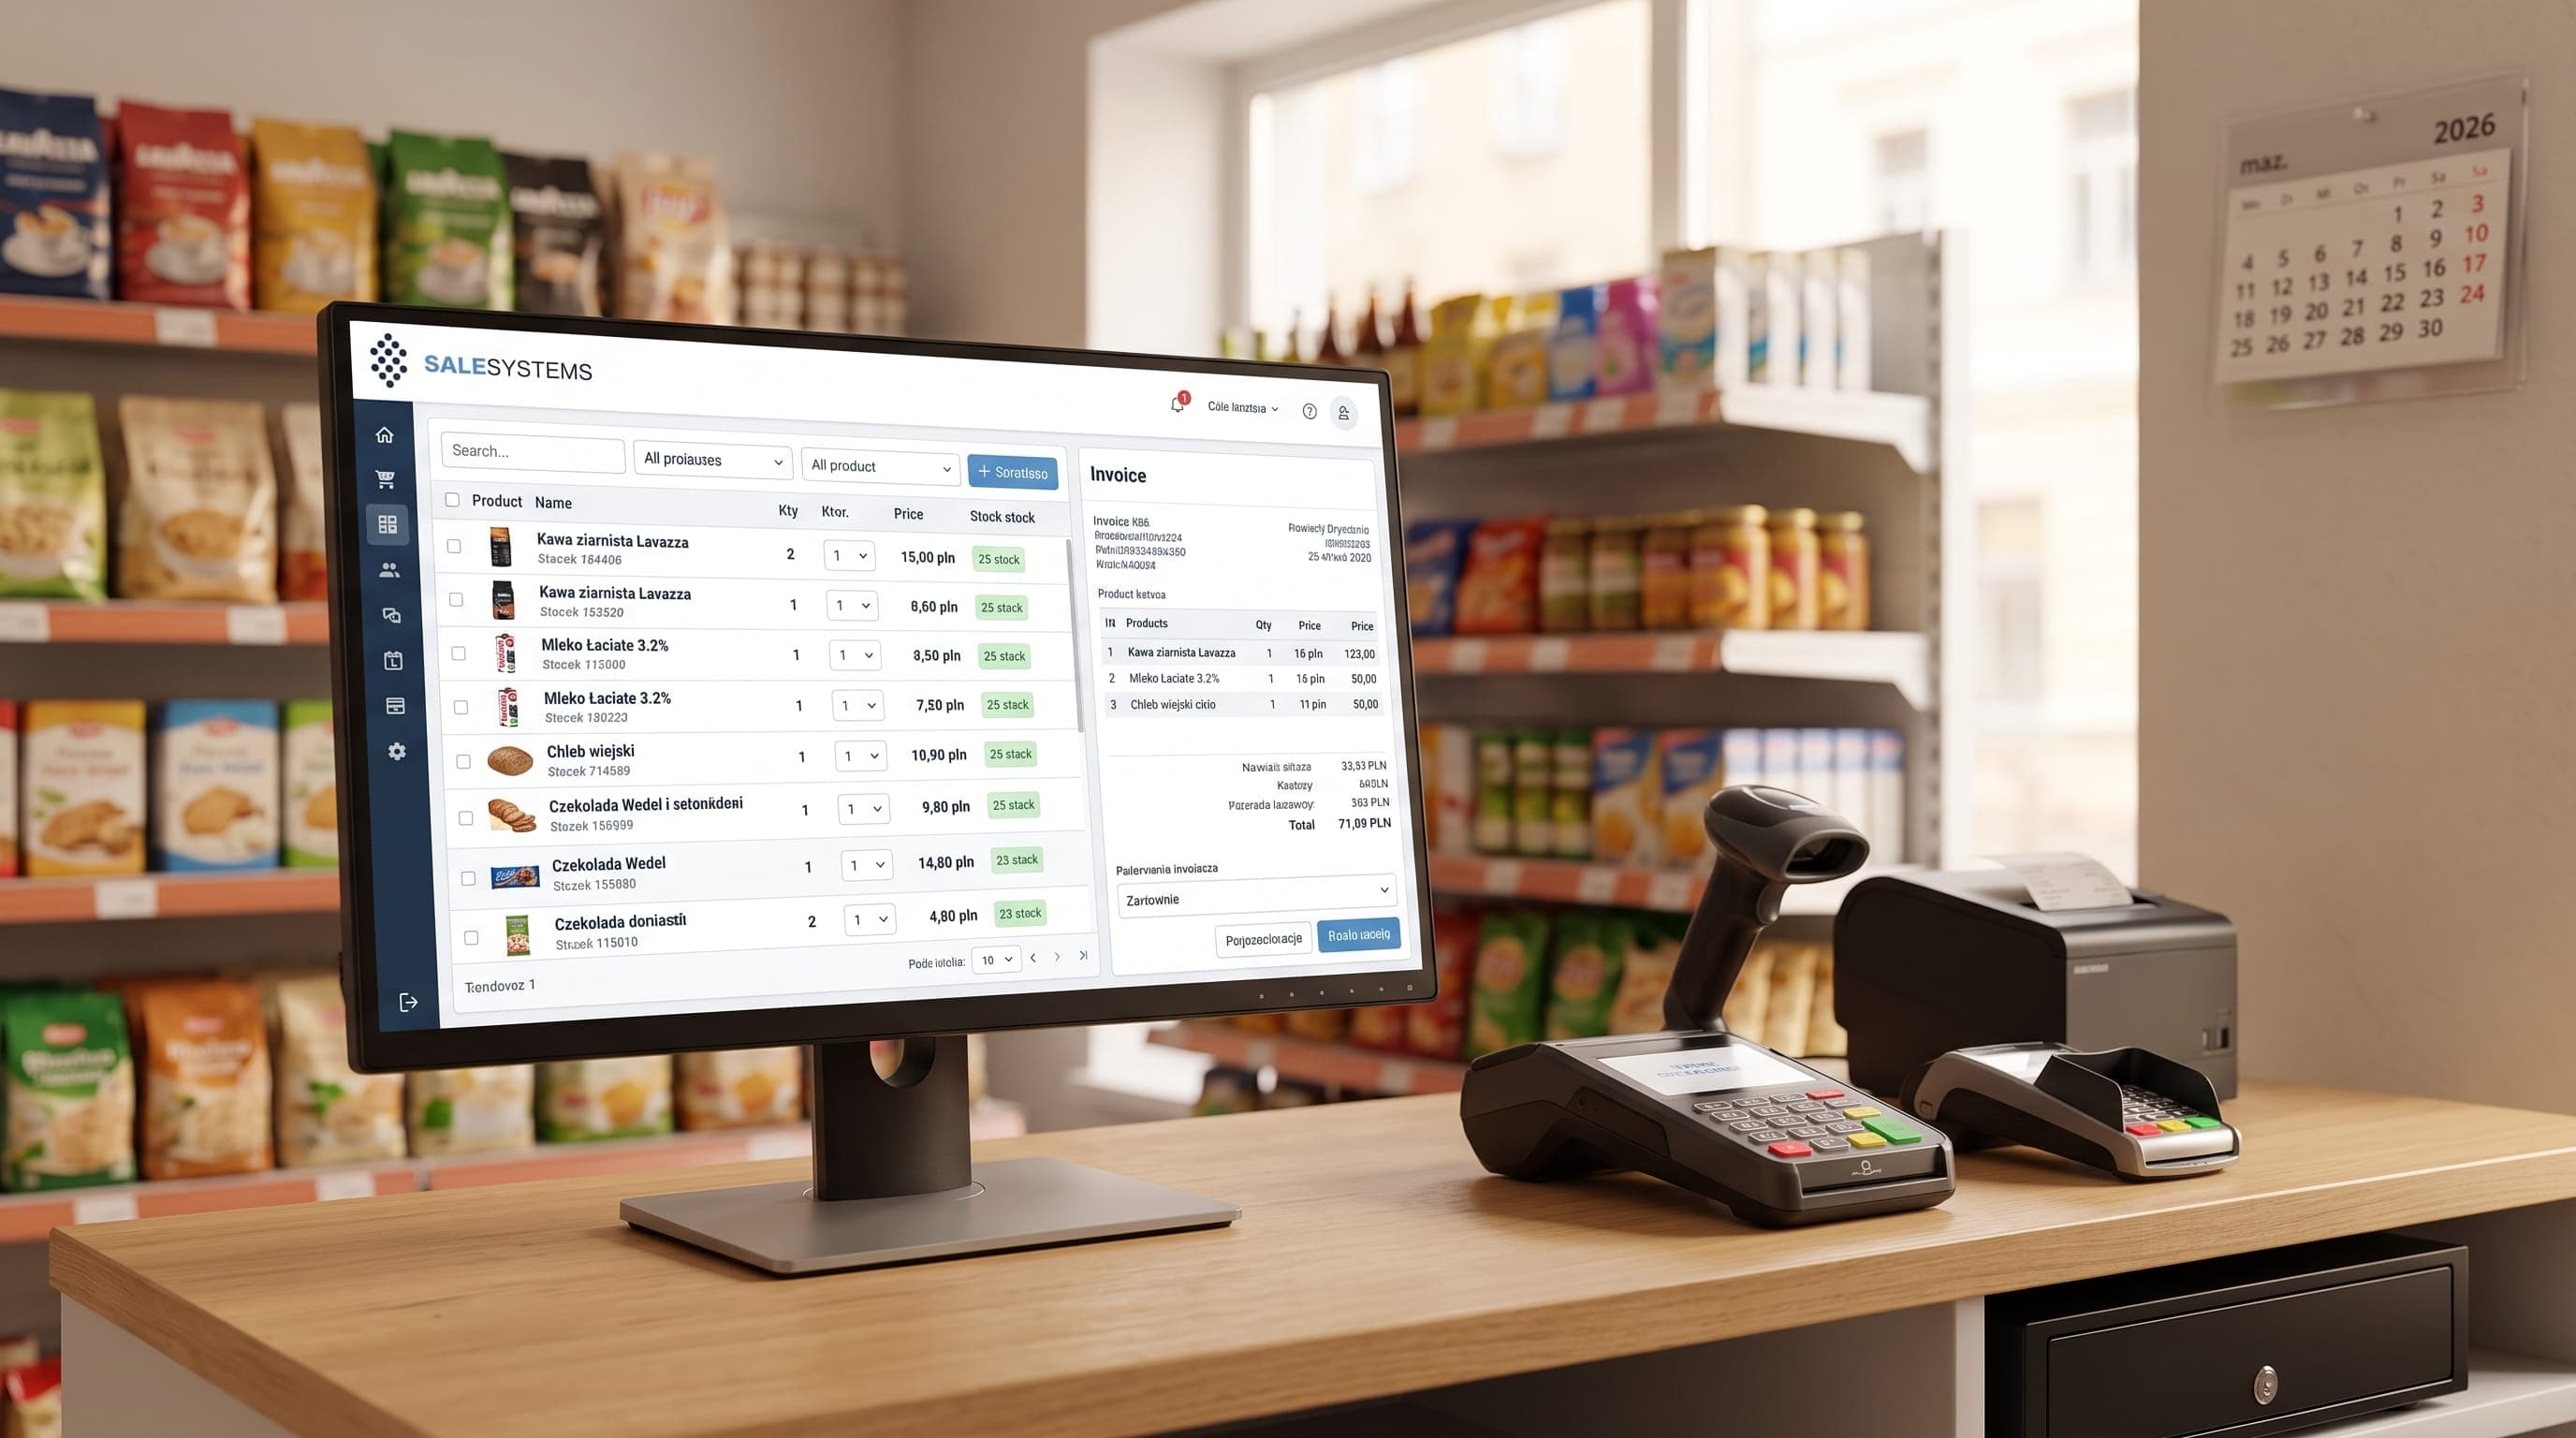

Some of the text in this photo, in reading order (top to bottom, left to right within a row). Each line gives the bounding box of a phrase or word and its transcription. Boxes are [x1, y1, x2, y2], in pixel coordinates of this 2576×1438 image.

[2433, 111, 2496, 145] 2026
[2394, 195, 2484, 223] 1 2 3
[2242, 224, 2488, 271] 4 5 6 7 8 9 10
[2237, 254, 2486, 301] 11 12 13 14 15 16 17
[2235, 285, 2484, 329] 18 19 20 21 22 23 24
[2230, 319, 2443, 358] 25 26 27 28 29 30
[424, 354, 593, 380] SALESYSTEMS
[453, 444, 508, 457] Search...
[645, 451, 659, 463] All
[812, 459, 876, 473] All product
[1091, 466, 1146, 483] Invoice
[473, 494, 522, 507] Product
[536, 496, 572, 508] Name
[779, 505, 798, 519] Kty
[895, 508, 923, 520] Price
[971, 510, 1034, 523] Stock stock
[1094, 516, 1129, 526] Invoice
[537, 533, 689, 548] Kawa ziarnista Lavazza
[787, 549, 795, 560] 2
[833, 549, 840, 562] 1
[901, 551, 955, 565] 15,00 pln
[979, 554, 1019, 565] 25 stock
[1309, 551, 1319, 561] 25
[1351, 553, 1371, 562] 2020
[540, 585, 691, 600] Kawa ziarnista Lavazza
[1099, 589, 1133, 599] Product
[790, 598, 797, 611] 1
[836, 599, 842, 611] 1
[912, 600, 958, 615] 8,60 pln
[982, 603, 994, 612] 25
[540, 607, 623, 617] Stocek 153520
[1127, 618, 1167, 627] Products
[1256, 620, 1271, 632] Qty
[1299, 621, 1321, 630] Price
[1352, 622, 1373, 631] Price
[542, 638, 668, 652] Mleko Łaciate 3.2%
[793, 649, 799, 661] 1
[840, 649, 845, 661] 1
[944, 650, 960, 664] pln
[985, 652, 996, 661] 25
[1107, 646, 1113, 657] 1
[1129, 647, 1236, 657] Kawa ziarnista Lavazza
[1266, 648, 1272, 658] 1
[1295, 649, 1323, 660] 16 pln
[1345, 650, 1375, 660] 123,00
[1109, 673, 1115, 682] 2
[1130, 673, 1220, 682] Mleko 3.2%
[1268, 673, 1274, 684] 1
[1352, 674, 1376, 685] 50,00
[545, 692, 671, 704] Mleko Łaciate 3.2%
[796, 699, 802, 712] 1
[842, 699, 848, 712] 1
[946, 699, 964, 713] pln
[988, 700, 1000, 710] 25
[1111, 699, 1116, 710] 3
[1131, 699, 1158, 710] Chleb
[1161, 699, 1193, 712] wiejski
[1270, 699, 1275, 710] 1
[1300, 700, 1309, 709] 11
[1354, 699, 1378, 711] 50,00
[548, 744, 634, 760] Chleb wiejski
[798, 751, 805, 763] 1
[845, 751, 851, 762] 1
[912, 749, 966, 763] 10,90 pln
[990, 749, 1032, 758] 25 stack
[590, 766, 630, 776] 714589
[1368, 761, 1386, 770] PLN
[549, 799, 618, 813] Czekolada
[622, 798, 662, 811] Wedel
[666, 797, 670, 811] i
[923, 800, 970, 815] 9,80 pln
[993, 799, 1034, 810] 25 stack
[1371, 798, 1389, 806] PLN
[801, 804, 808, 816] 1
[847, 803, 854, 815] 1
[1289, 819, 1314, 830] Total
[1339, 817, 1391, 830] 71,09 PLN
[553, 856, 666, 872] Czekolada Wedel
[805, 860, 812, 873] 1
[851, 859, 856, 872] 1
[919, 856, 973, 871] 14,80 pln
[997, 856, 1009, 865] 23
[930, 909, 977, 924] 4,80 pln
[1000, 909, 1012, 918] 23
[555, 916, 624, 931] Czekolada
[809, 916, 816, 927] 2
[855, 914, 860, 926] 1
[597, 936, 637, 948] 115010
[983, 956, 993, 964] 10
[529, 978, 534, 990] 1
